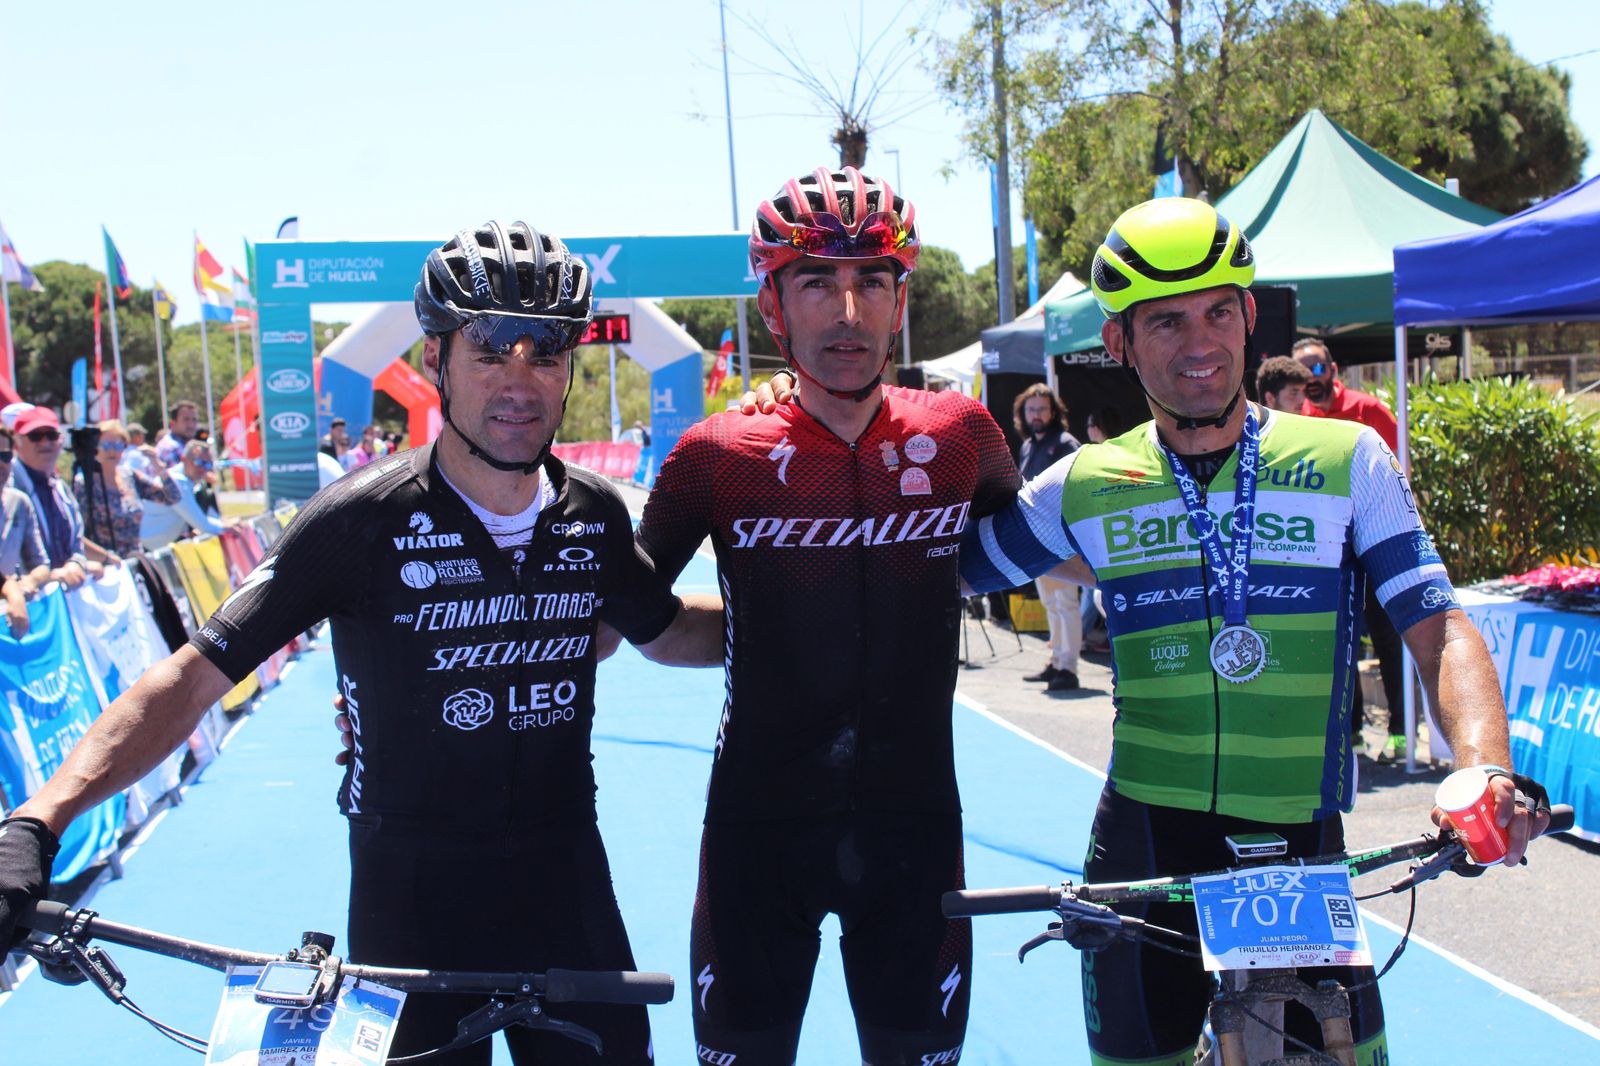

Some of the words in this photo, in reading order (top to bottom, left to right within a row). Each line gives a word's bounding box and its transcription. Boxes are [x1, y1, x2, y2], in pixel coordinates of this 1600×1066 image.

[308, 257, 384, 269] DIPUTACIÓN
[308, 271, 325, 282] DE
[328, 270, 377, 282] HUELVA
[1239, 442, 1258, 476] HUEX
[1174, 473, 1199, 505] HUEX
[1242, 477, 1250, 497] 2019
[551, 521, 605, 537] CROWN
[732, 501, 972, 548] SPECIALIZED
[393, 533, 464, 551] VIATOR
[1208, 541, 1222, 563] 2019
[1267, 543, 1317, 553] COMPANY
[434, 558, 478, 569] SANTIAGO
[543, 563, 601, 572] OAKLEY
[1230, 539, 1249, 577] HUEX
[437, 565, 482, 579] ROJAS
[1233, 578, 1242, 601] 2019
[394, 614, 414, 624] PRO
[533, 592, 595, 621] TORRES
[426, 635, 590, 671] SPECIALIZED
[1150, 644, 1190, 660] LUQUE
[1233, 639, 1253, 654] 2019
[1219, 641, 1261, 676] HUEX
[508, 680, 577, 713] LEO
[1549, 682, 1584, 730] DE
[508, 707, 575, 731] GRUPO
[343, 674, 364, 814] VIATOR
[1233, 872, 1306, 894] HUEX
[1221, 893, 1304, 928] 707
[1203, 905, 1216, 940] INDIVIDUAL
[1238, 946, 1278, 954] TRUJILLO
[1280, 944, 1332, 952] HERNANDEZ
[266, 997, 297, 1006] GARMIN
[258, 1046, 299, 1056] RAMIREZ
